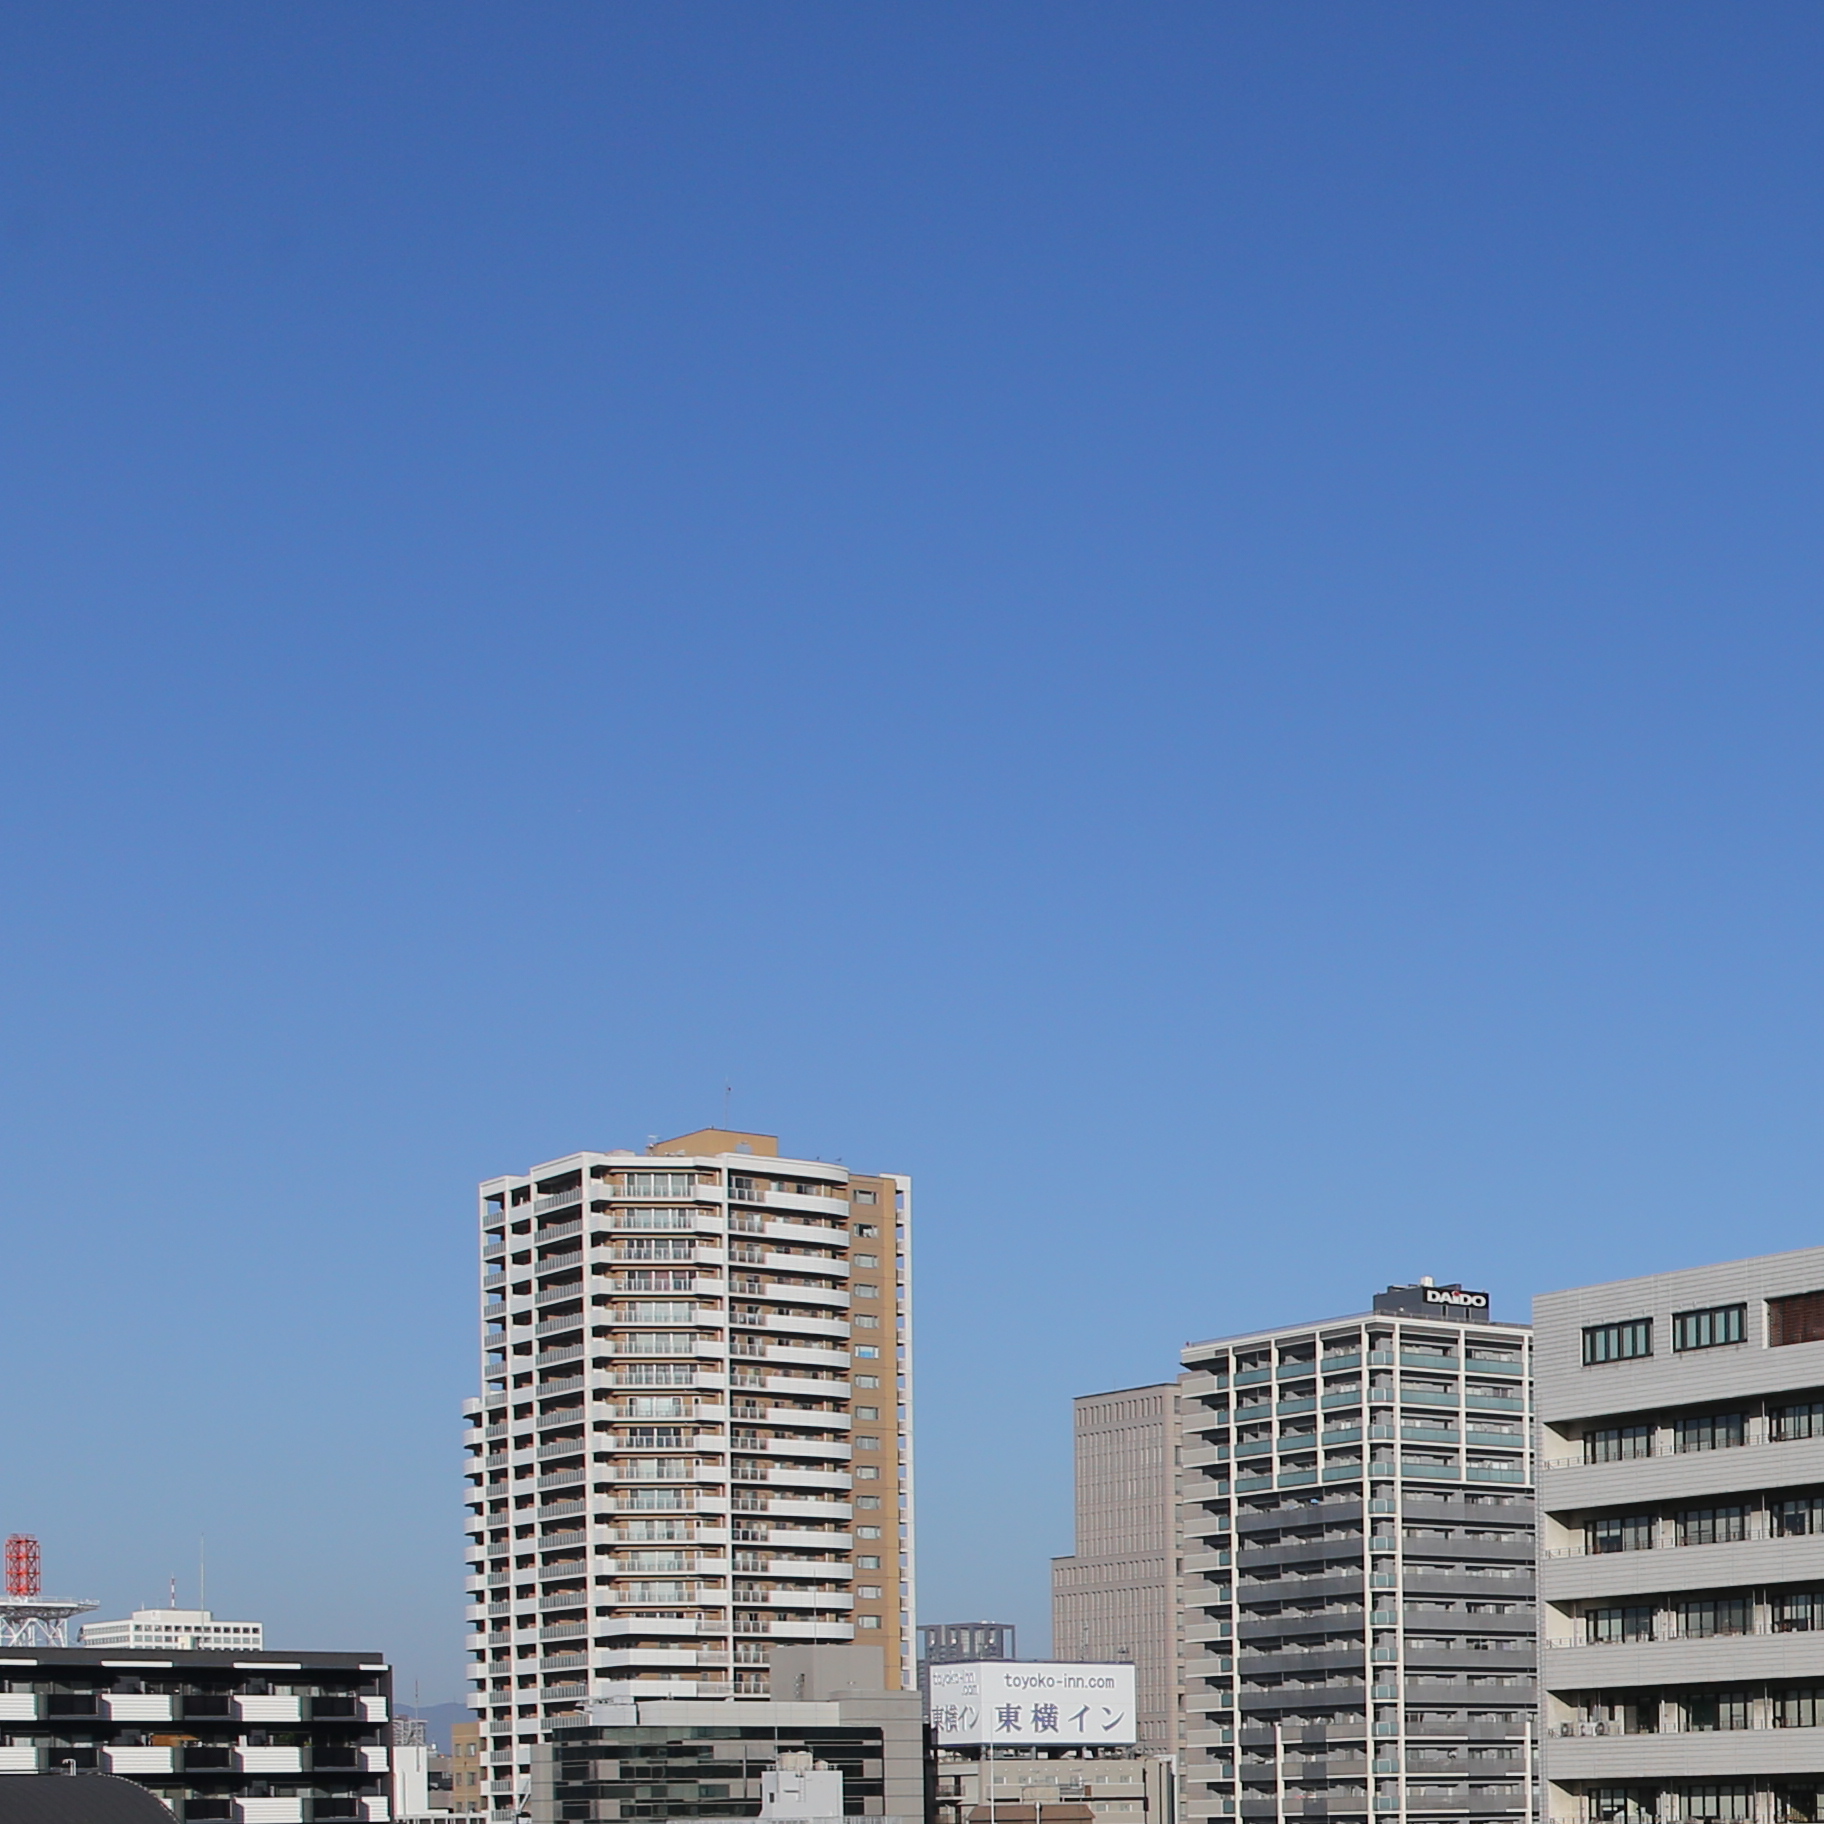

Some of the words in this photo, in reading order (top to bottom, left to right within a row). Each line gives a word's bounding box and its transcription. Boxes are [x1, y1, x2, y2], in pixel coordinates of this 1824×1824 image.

[932, 1669, 976, 1688] toyoko-inn
[1004, 1673, 1115, 1690] toyoko-inn.com
[931, 1704, 980, 1733] 東横イン
[994, 1702, 1126, 1734] 東横イン
